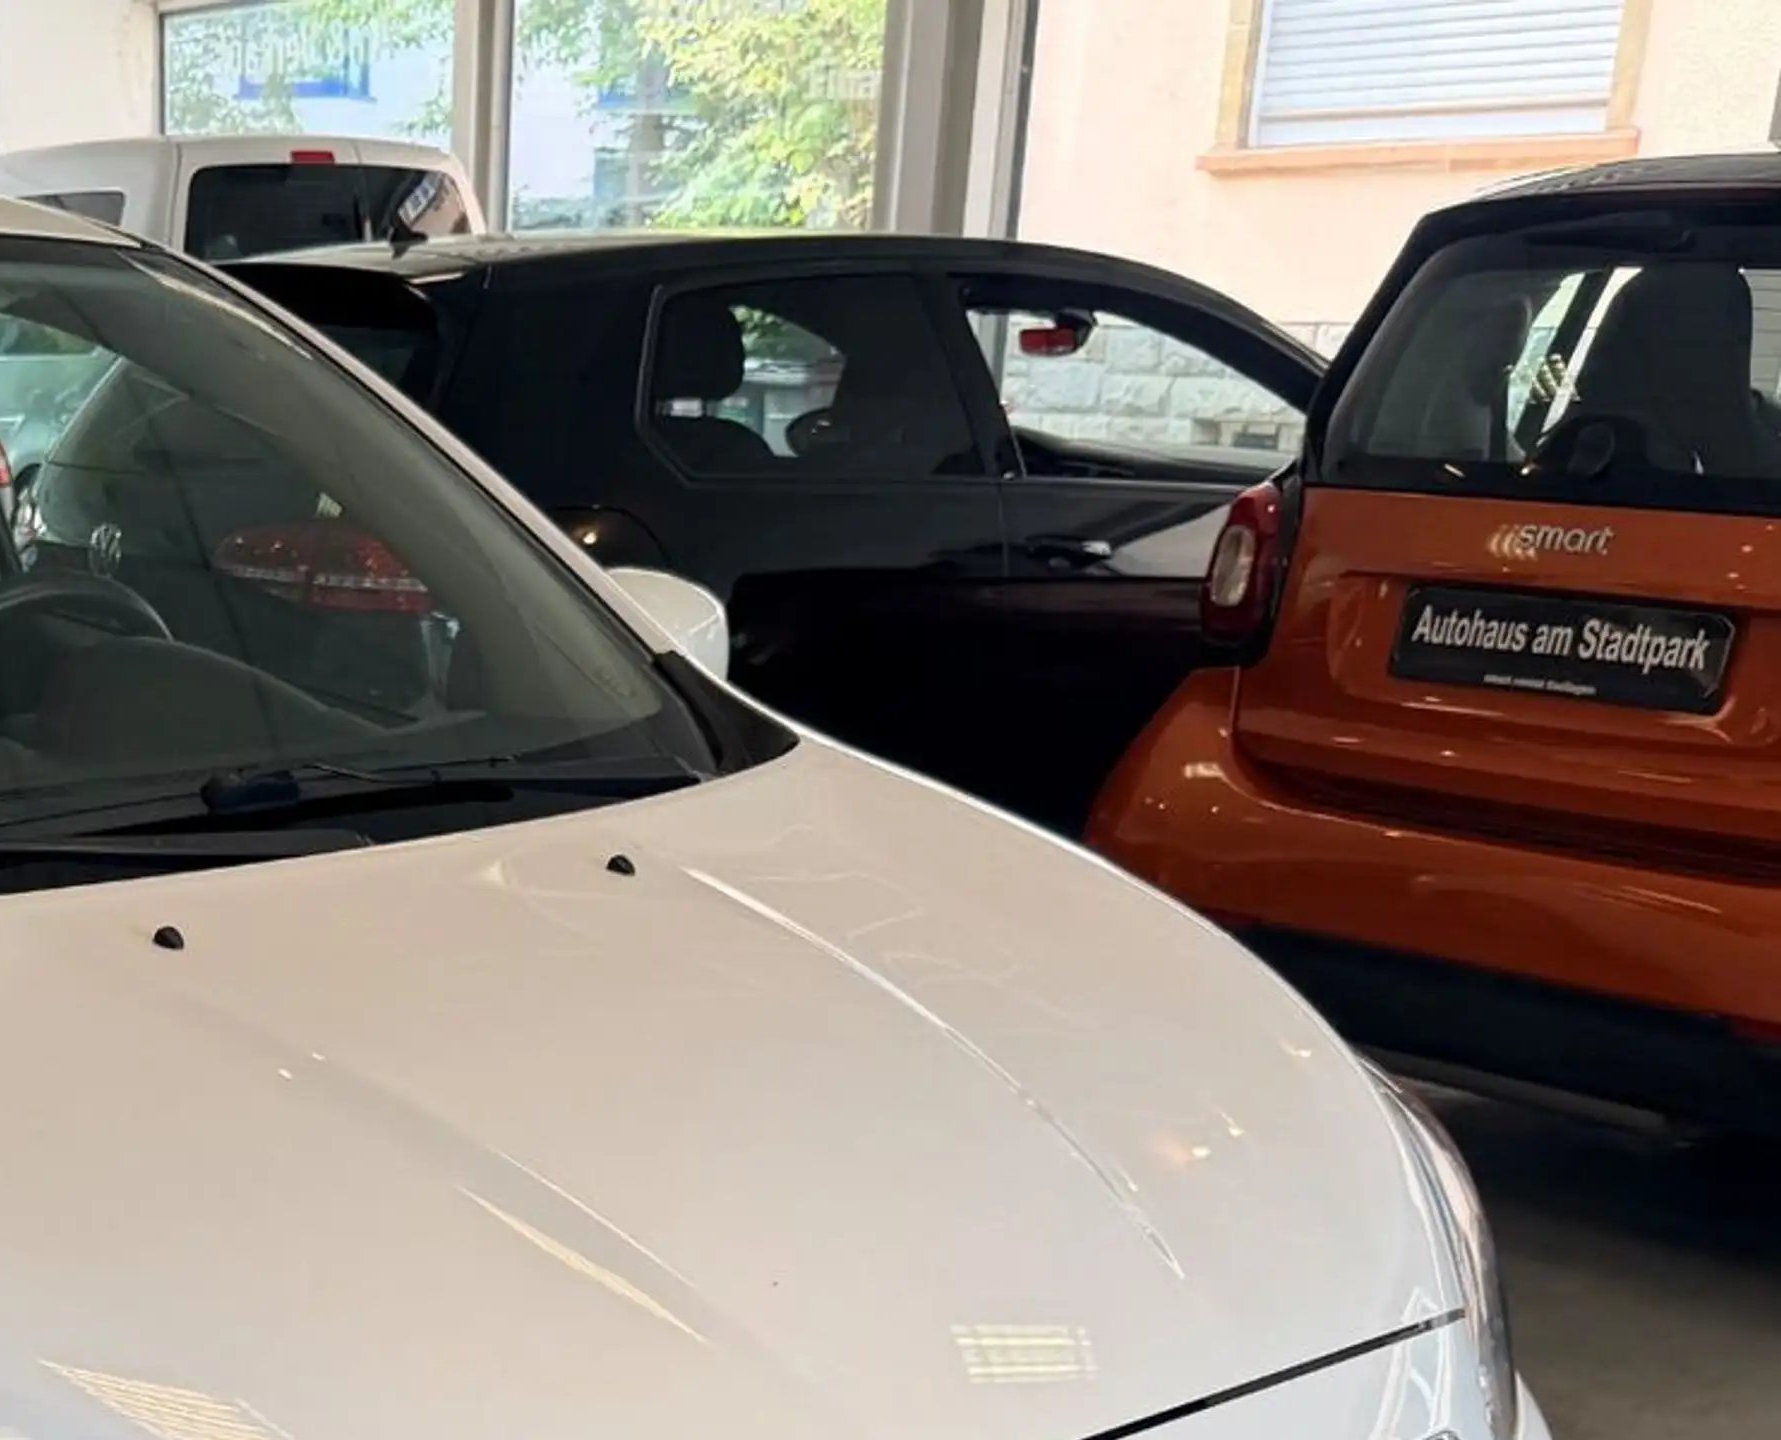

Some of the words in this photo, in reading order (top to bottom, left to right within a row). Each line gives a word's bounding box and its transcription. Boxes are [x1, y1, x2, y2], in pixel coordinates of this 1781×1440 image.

[1519, 524, 1615, 554] smart
[1411, 604, 1526, 652] Autohaus
[1532, 625, 1573, 657] am
[1578, 618, 1710, 675] Stadtpark
